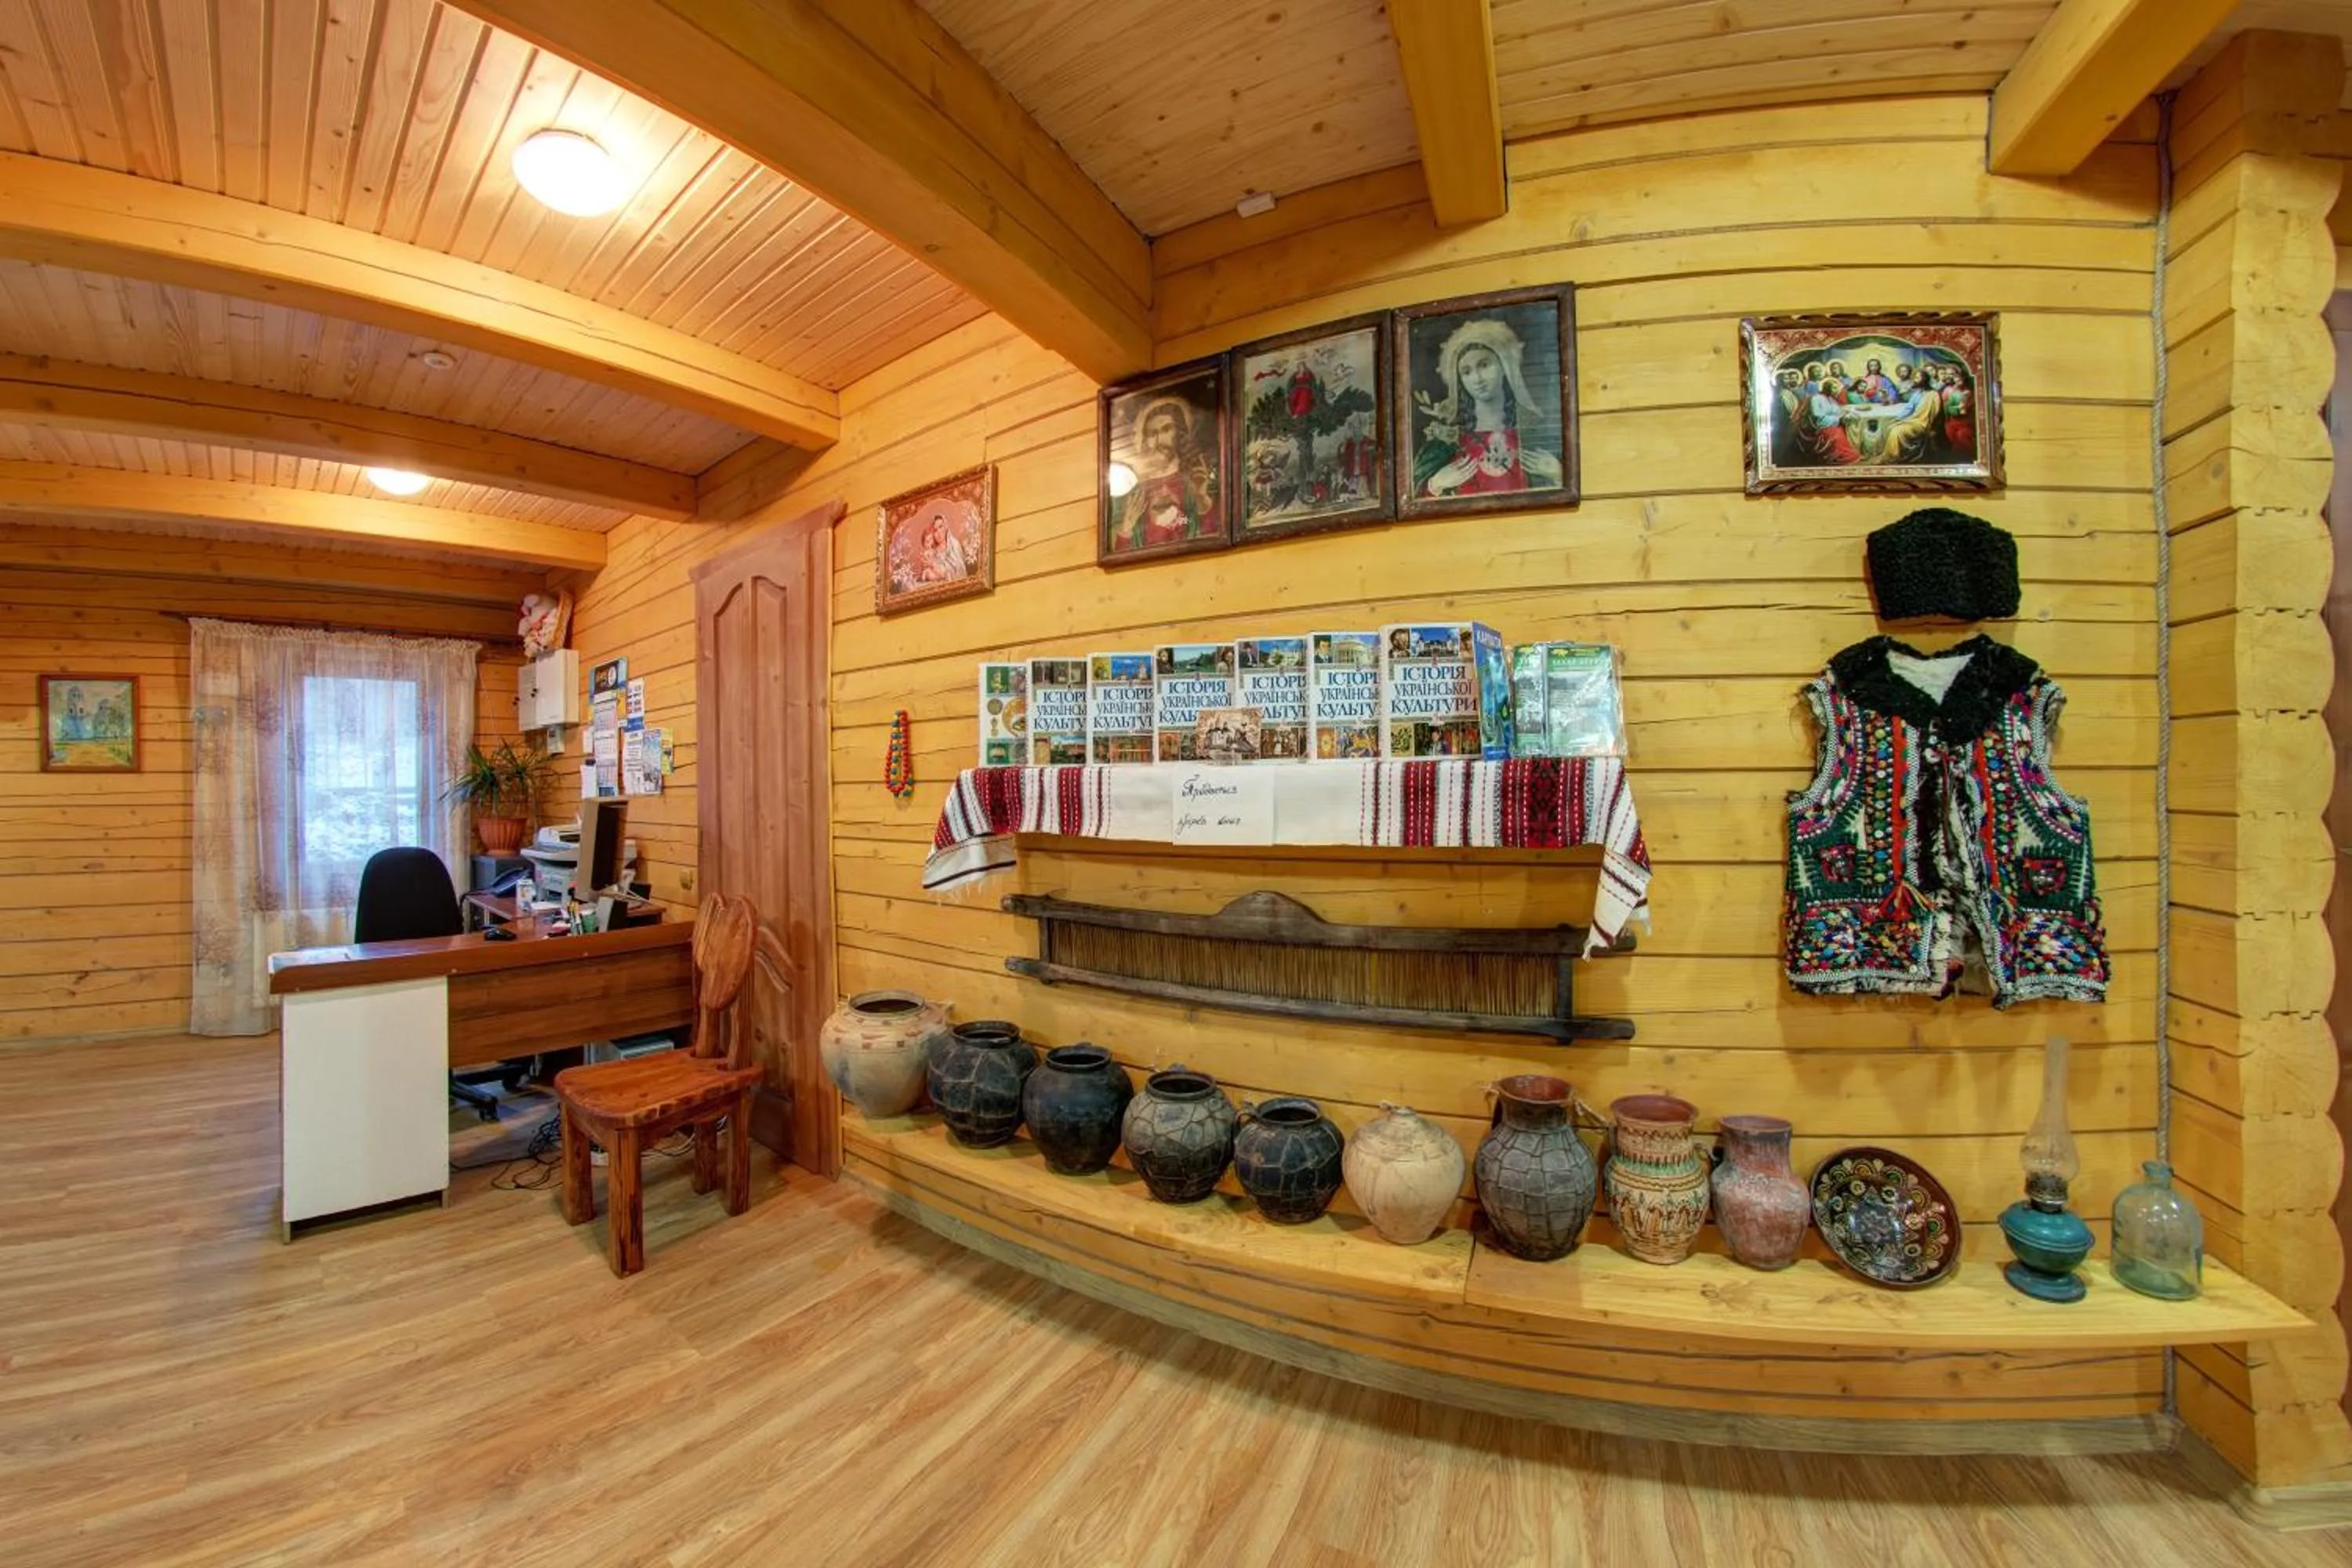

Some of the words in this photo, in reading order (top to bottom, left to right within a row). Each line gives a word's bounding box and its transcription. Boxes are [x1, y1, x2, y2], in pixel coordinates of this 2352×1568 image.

[1403, 666, 1466, 681] ІСТОРІЯ
[1168, 680, 1226, 693] ІСТОРІЯ
[1394, 679, 1473, 698] УКРАЇНСЬКОЇ
[1161, 692, 1232, 710] УКРАЇНСЬКОЇ
[1391, 697, 1478, 715] КУЛЬТУРИ
[1159, 710, 1198, 724] КУЛЬ
